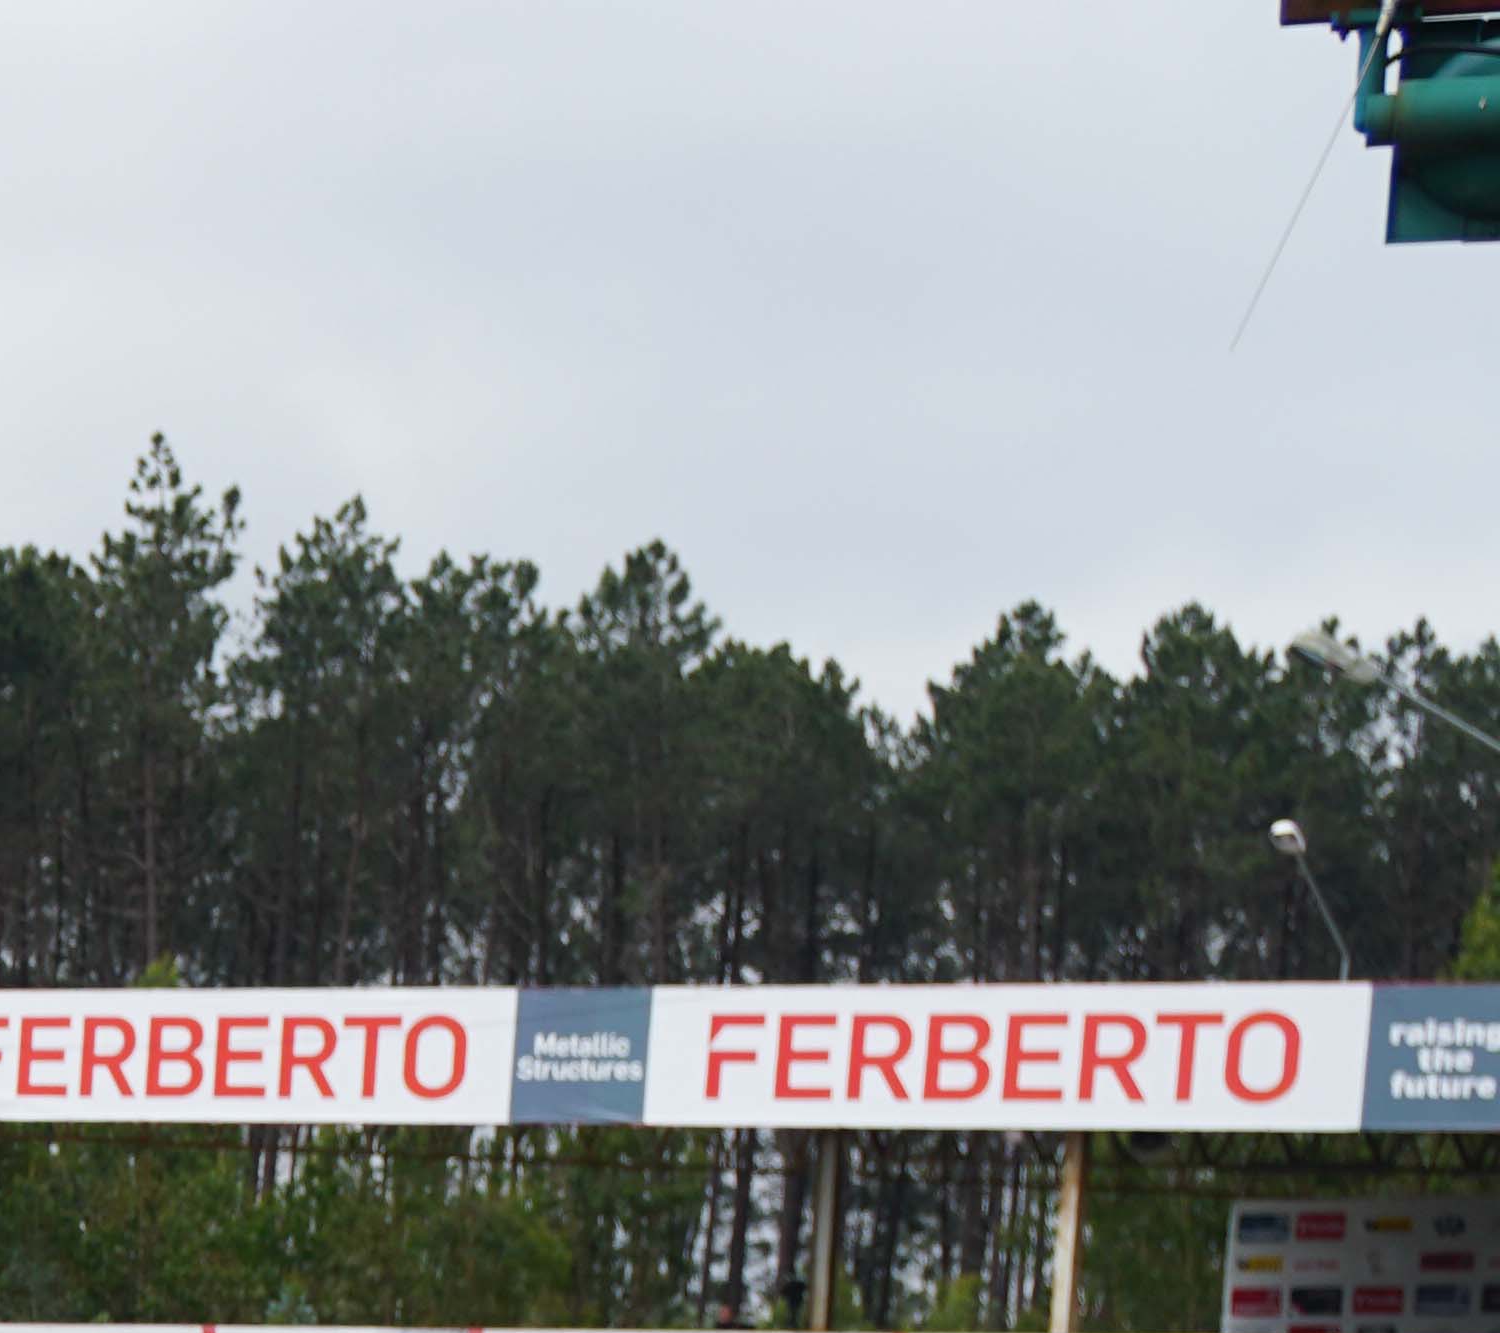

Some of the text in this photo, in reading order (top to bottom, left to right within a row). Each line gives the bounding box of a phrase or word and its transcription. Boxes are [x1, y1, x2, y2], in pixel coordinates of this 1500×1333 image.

[533, 1031, 631, 1057] Metallic
[703, 1010, 1303, 1104] FERBERTO
[516, 1055, 644, 1083] Structures
[1418, 1045, 1473, 1073] the
[1389, 1071, 1495, 1102] future
